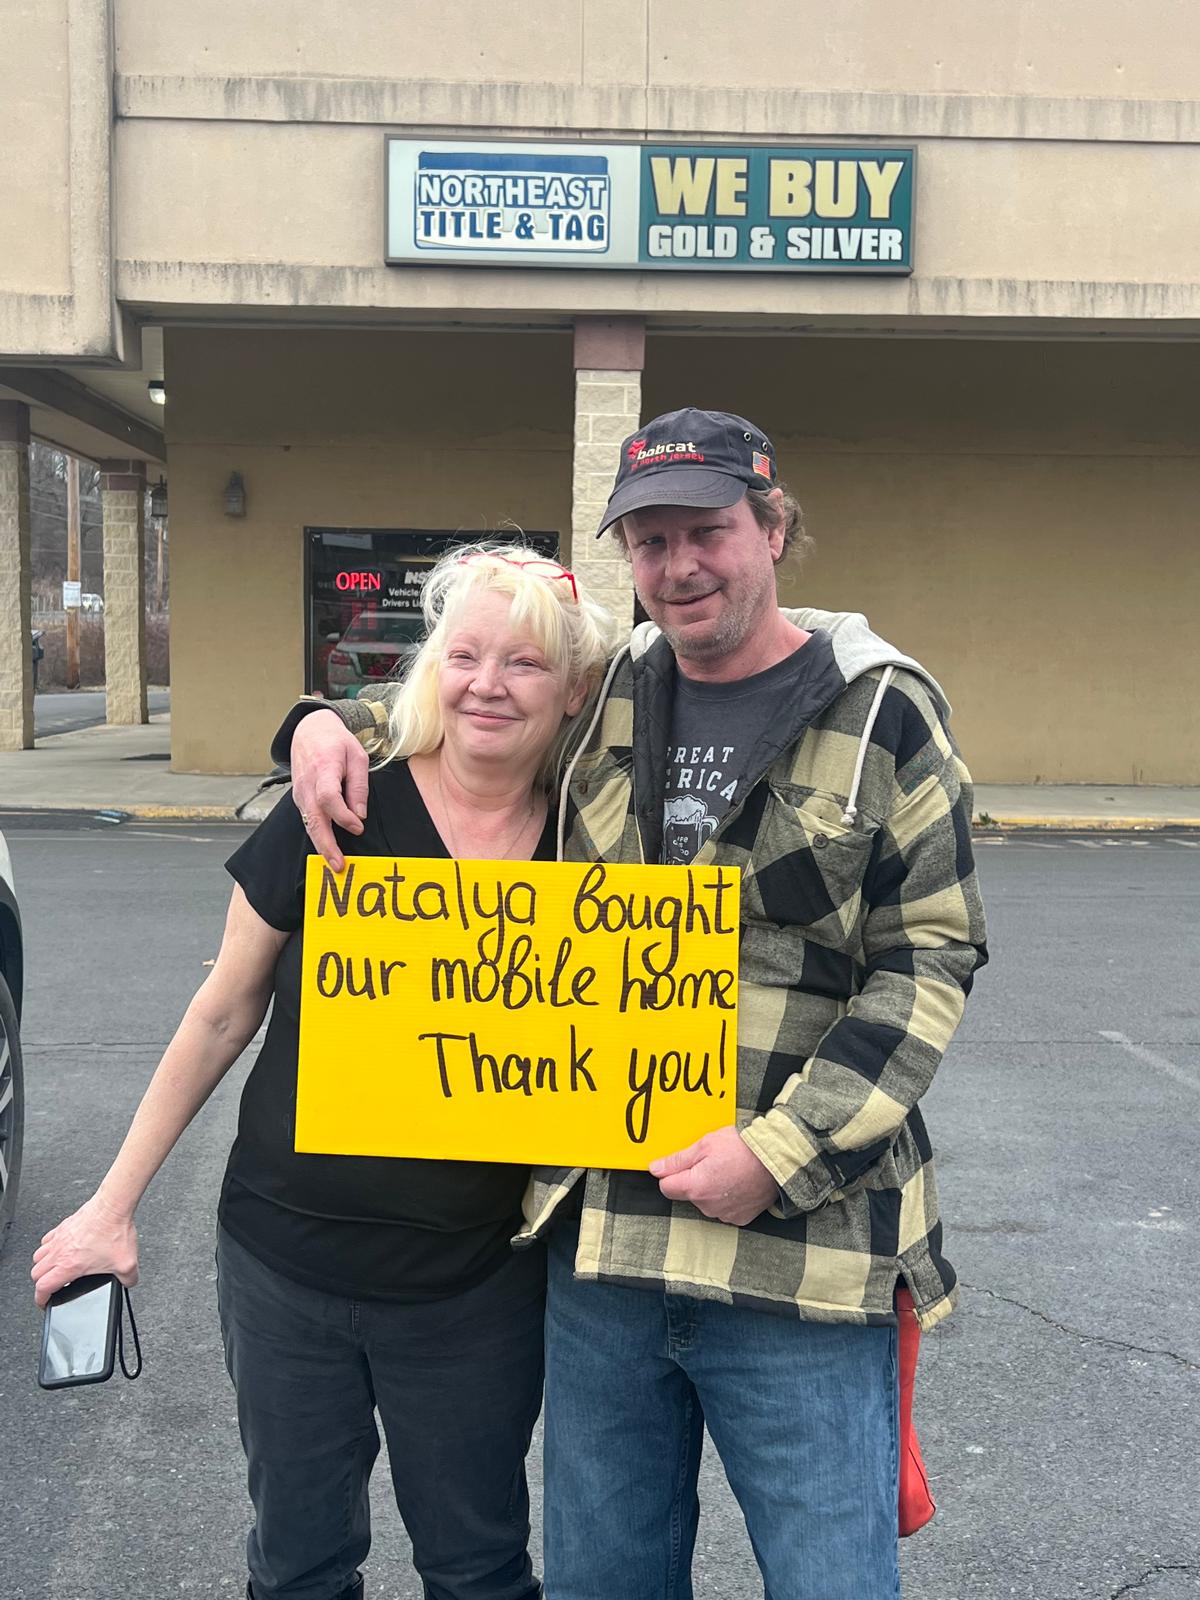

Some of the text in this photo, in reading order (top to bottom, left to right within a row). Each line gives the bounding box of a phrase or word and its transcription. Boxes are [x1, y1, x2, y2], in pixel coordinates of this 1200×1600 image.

[418, 174, 607, 209] NORTHEAST
[649, 157, 904, 219] WE BUY
[420, 211, 605, 241] TITLE & TAG
[648, 225, 903, 261] GOLD & SILVER
[637, 441, 697, 460] bobcat
[336, 572, 381, 591] OPEN
[382, 599, 409, 607] Drivers
[666, 746, 734, 764] REAT
[318, 862, 735, 976] Natalya bought
[317, 934, 736, 1013] our mobile home
[418, 1019, 726, 1143] Thank you!
